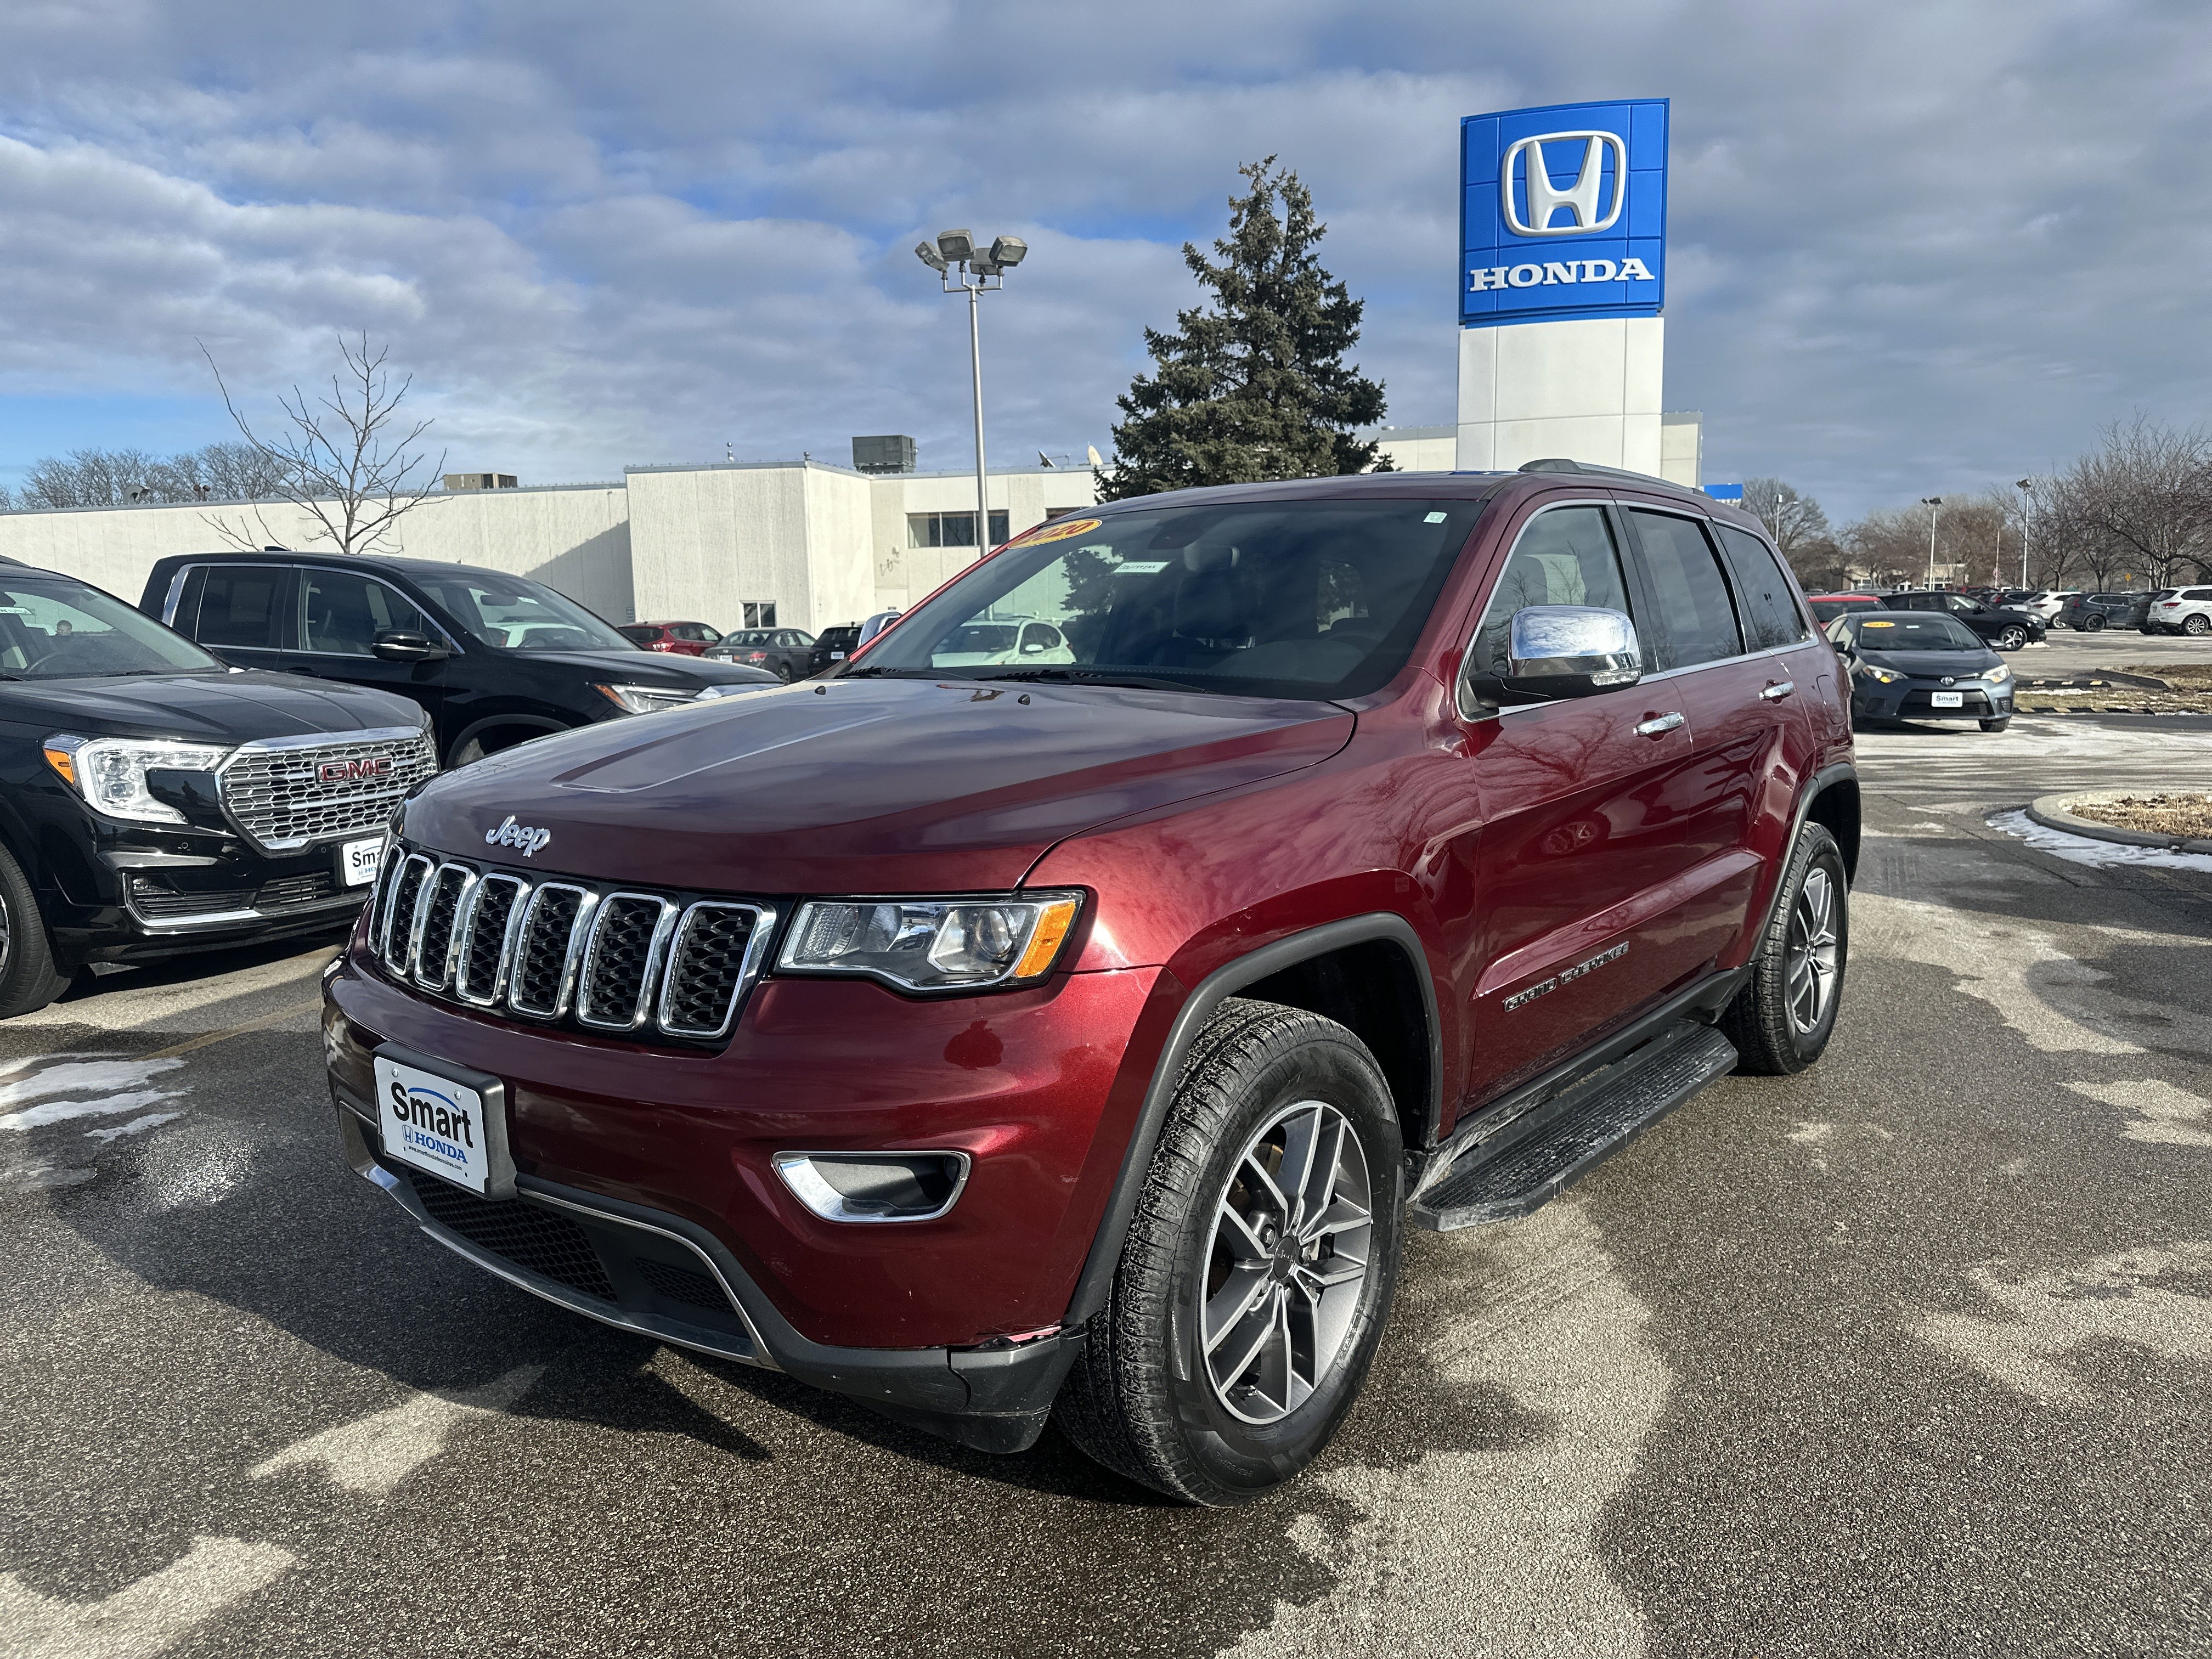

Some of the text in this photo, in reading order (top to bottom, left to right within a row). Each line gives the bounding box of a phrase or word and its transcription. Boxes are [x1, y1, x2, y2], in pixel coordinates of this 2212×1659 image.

[1469, 258, 1655, 291] HONDA
[1013, 522, 1094, 546] 2020
[320, 757, 394, 781] GMC
[486, 815, 551, 857] Jeep
[1503, 941, 1629, 1013] GRAND CHEROKEE
[391, 1082, 473, 1148] Smart
[415, 1131, 468, 1164] HONDA
